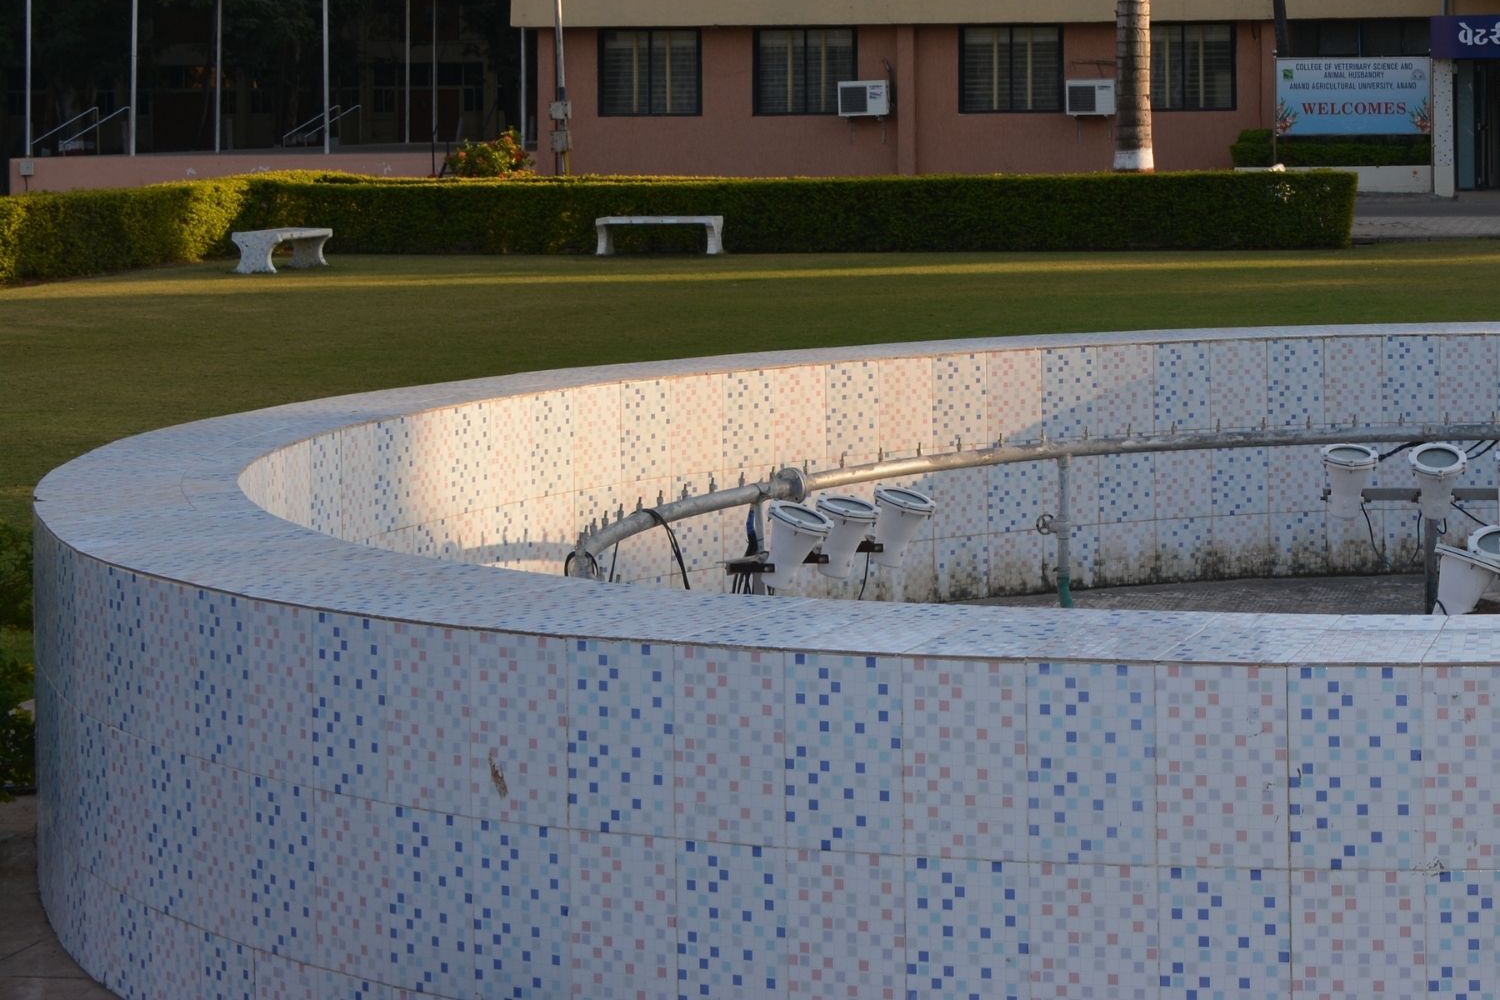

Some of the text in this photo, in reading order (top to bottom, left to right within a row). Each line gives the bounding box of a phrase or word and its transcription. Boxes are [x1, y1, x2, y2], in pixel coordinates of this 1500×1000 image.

[1295, 63, 1322, 71] COLLEGE
[1324, 63, 1332, 71] OF
[1334, 63, 1371, 71] VETERINARY
[1373, 63, 1399, 71] SCIENCE
[1323, 71, 1385, 79] ANIMAL HUSBANDRY
[1289, 82, 1310, 90] ANAND
[1311, 82, 1356, 90] AGRICULTURAL
[1396, 82, 1417, 90] ANAND
[1302, 102, 1407, 116] WELCOMES
